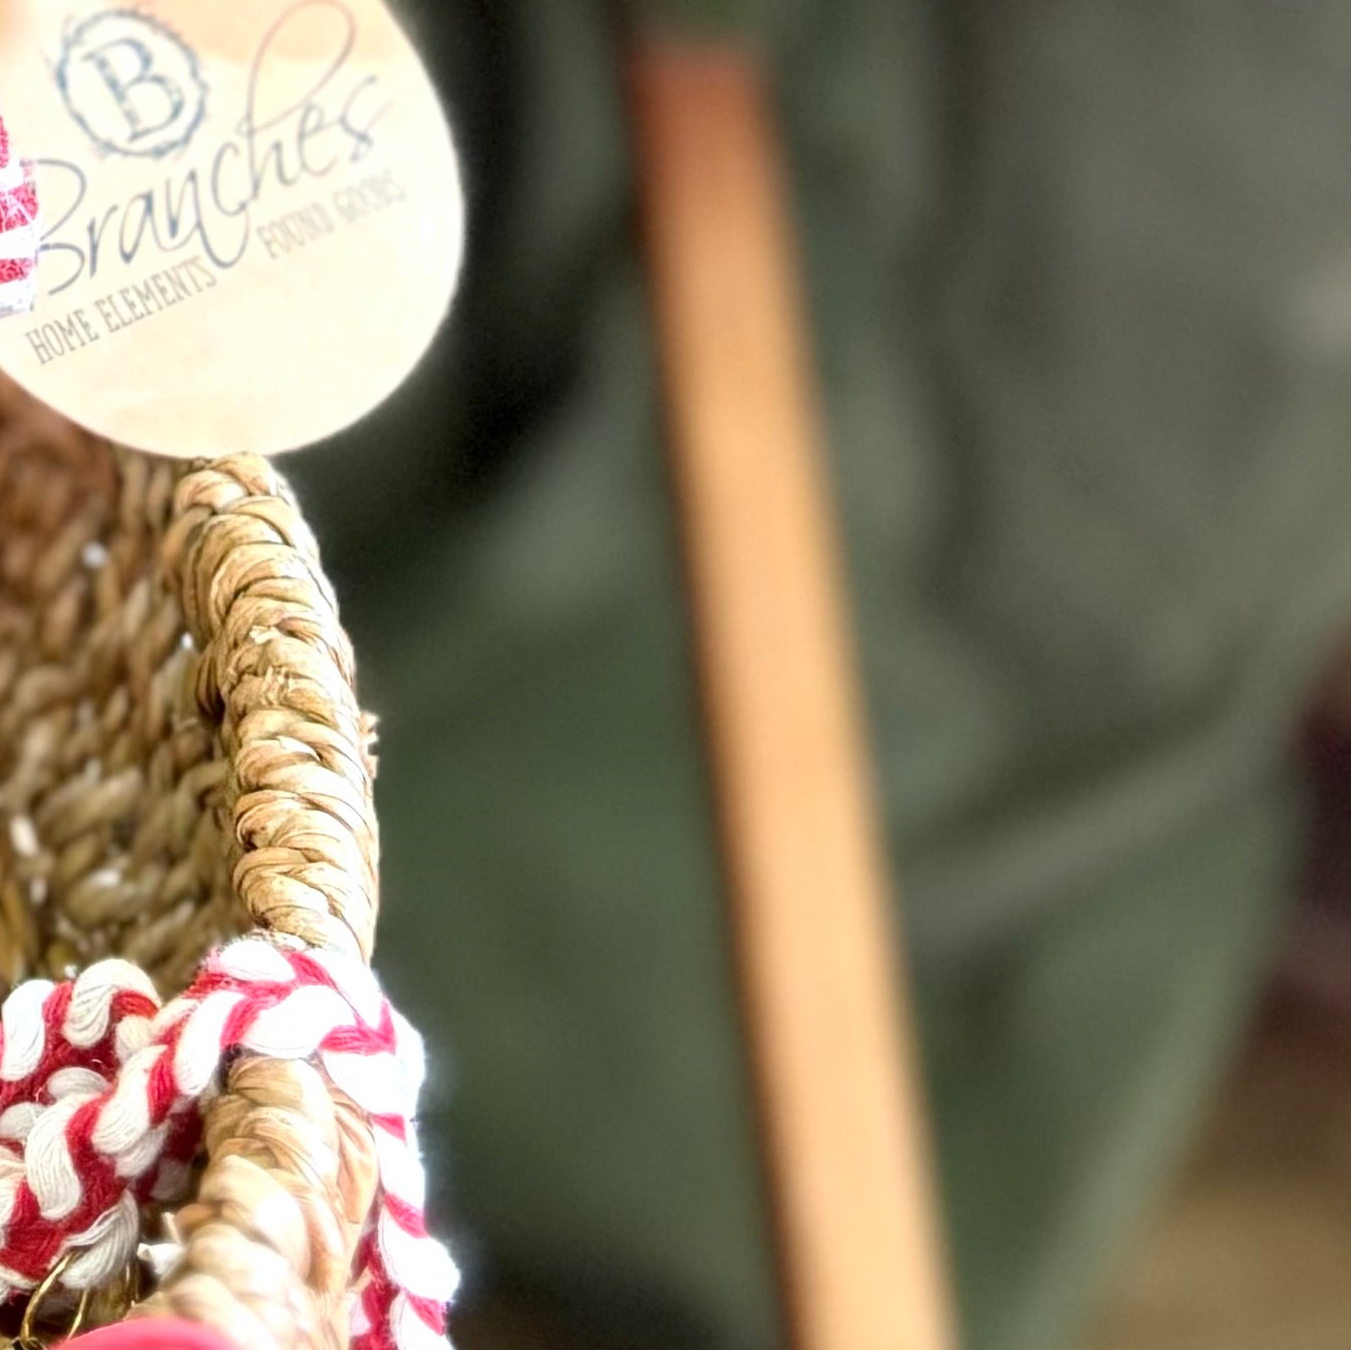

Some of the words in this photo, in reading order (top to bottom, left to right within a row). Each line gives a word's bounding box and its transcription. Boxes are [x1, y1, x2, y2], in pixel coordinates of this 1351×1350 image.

[82, 38, 184, 143] B
[25, 306, 100, 366] HOME
[93, 254, 218, 334] ELEMENTS
